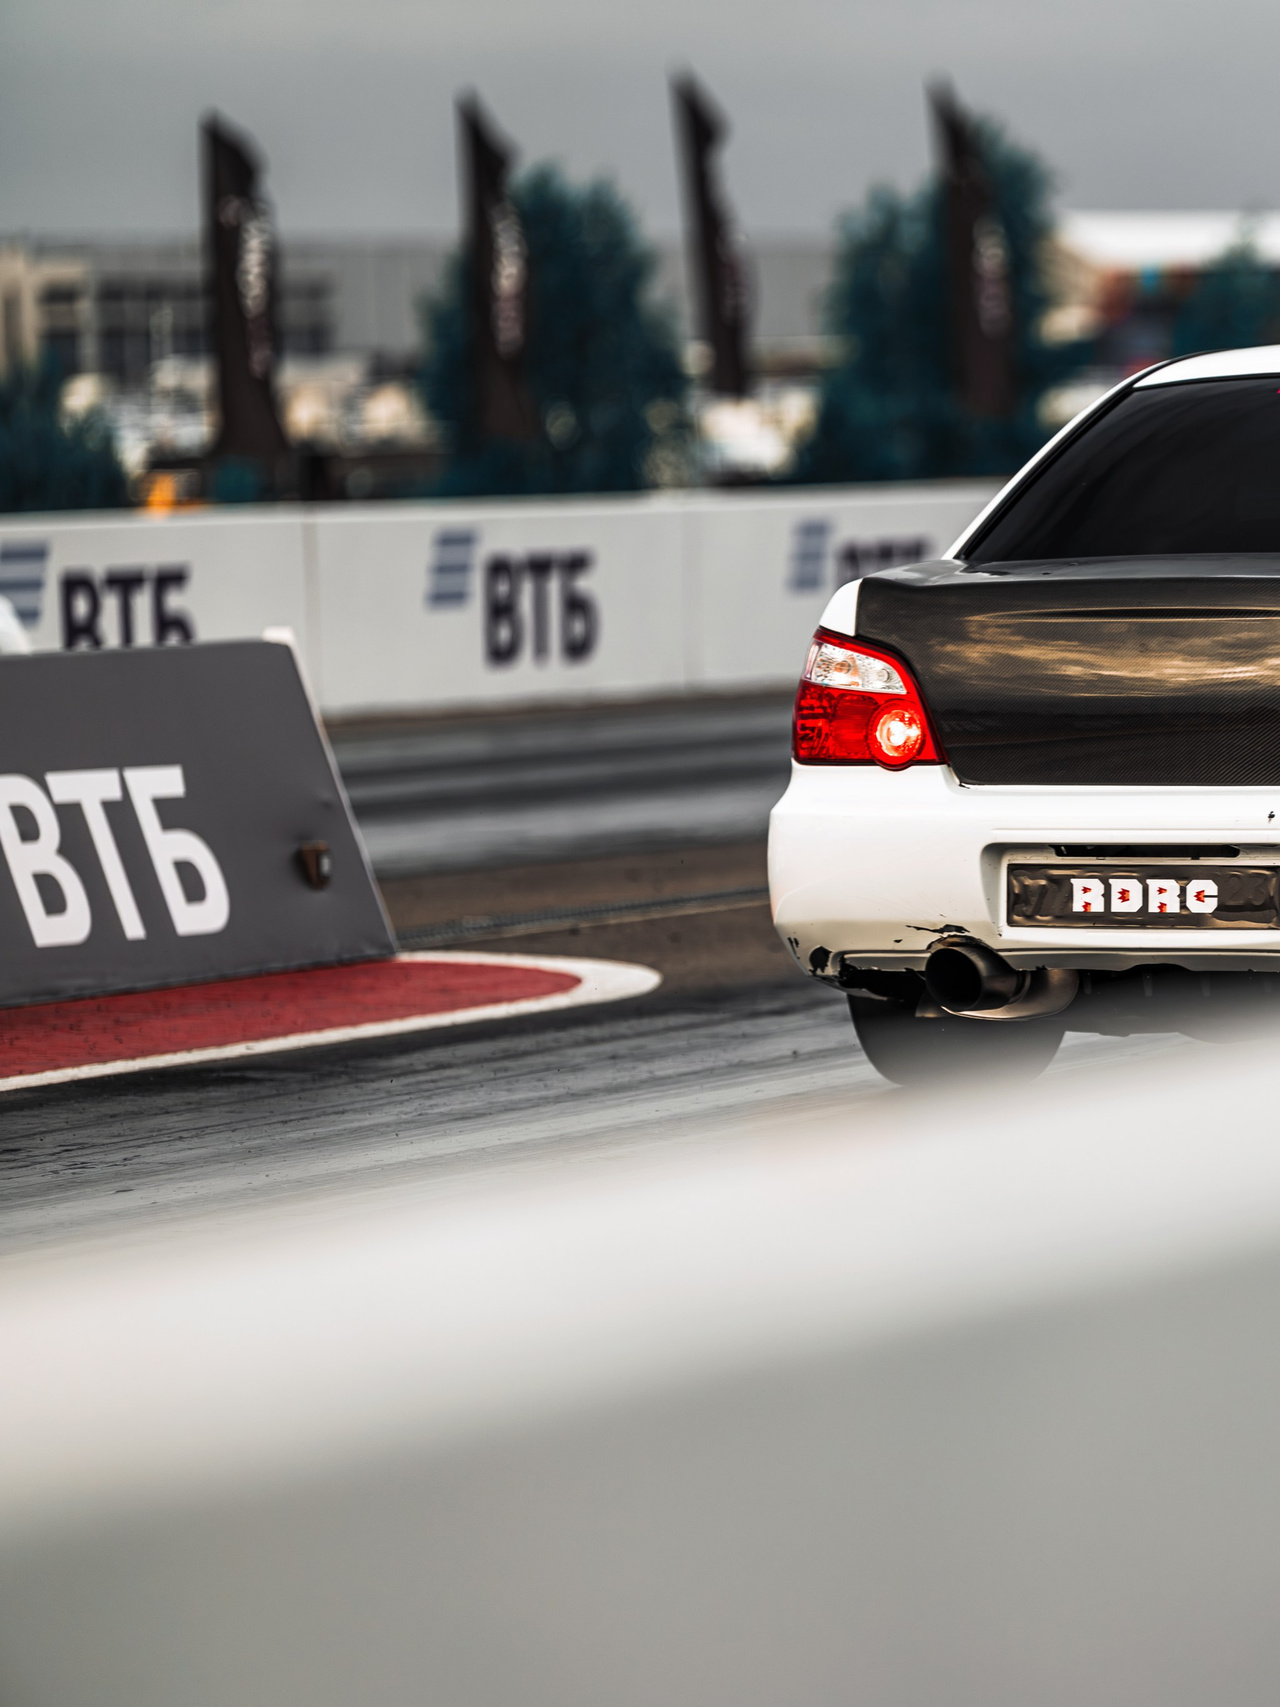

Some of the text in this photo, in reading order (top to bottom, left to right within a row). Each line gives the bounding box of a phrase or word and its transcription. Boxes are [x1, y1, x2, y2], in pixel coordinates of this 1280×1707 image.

[484, 551, 599, 669] ВТБ
[0, 765, 230, 948] ВТБ
[1070, 879, 1218, 914] RDRC
